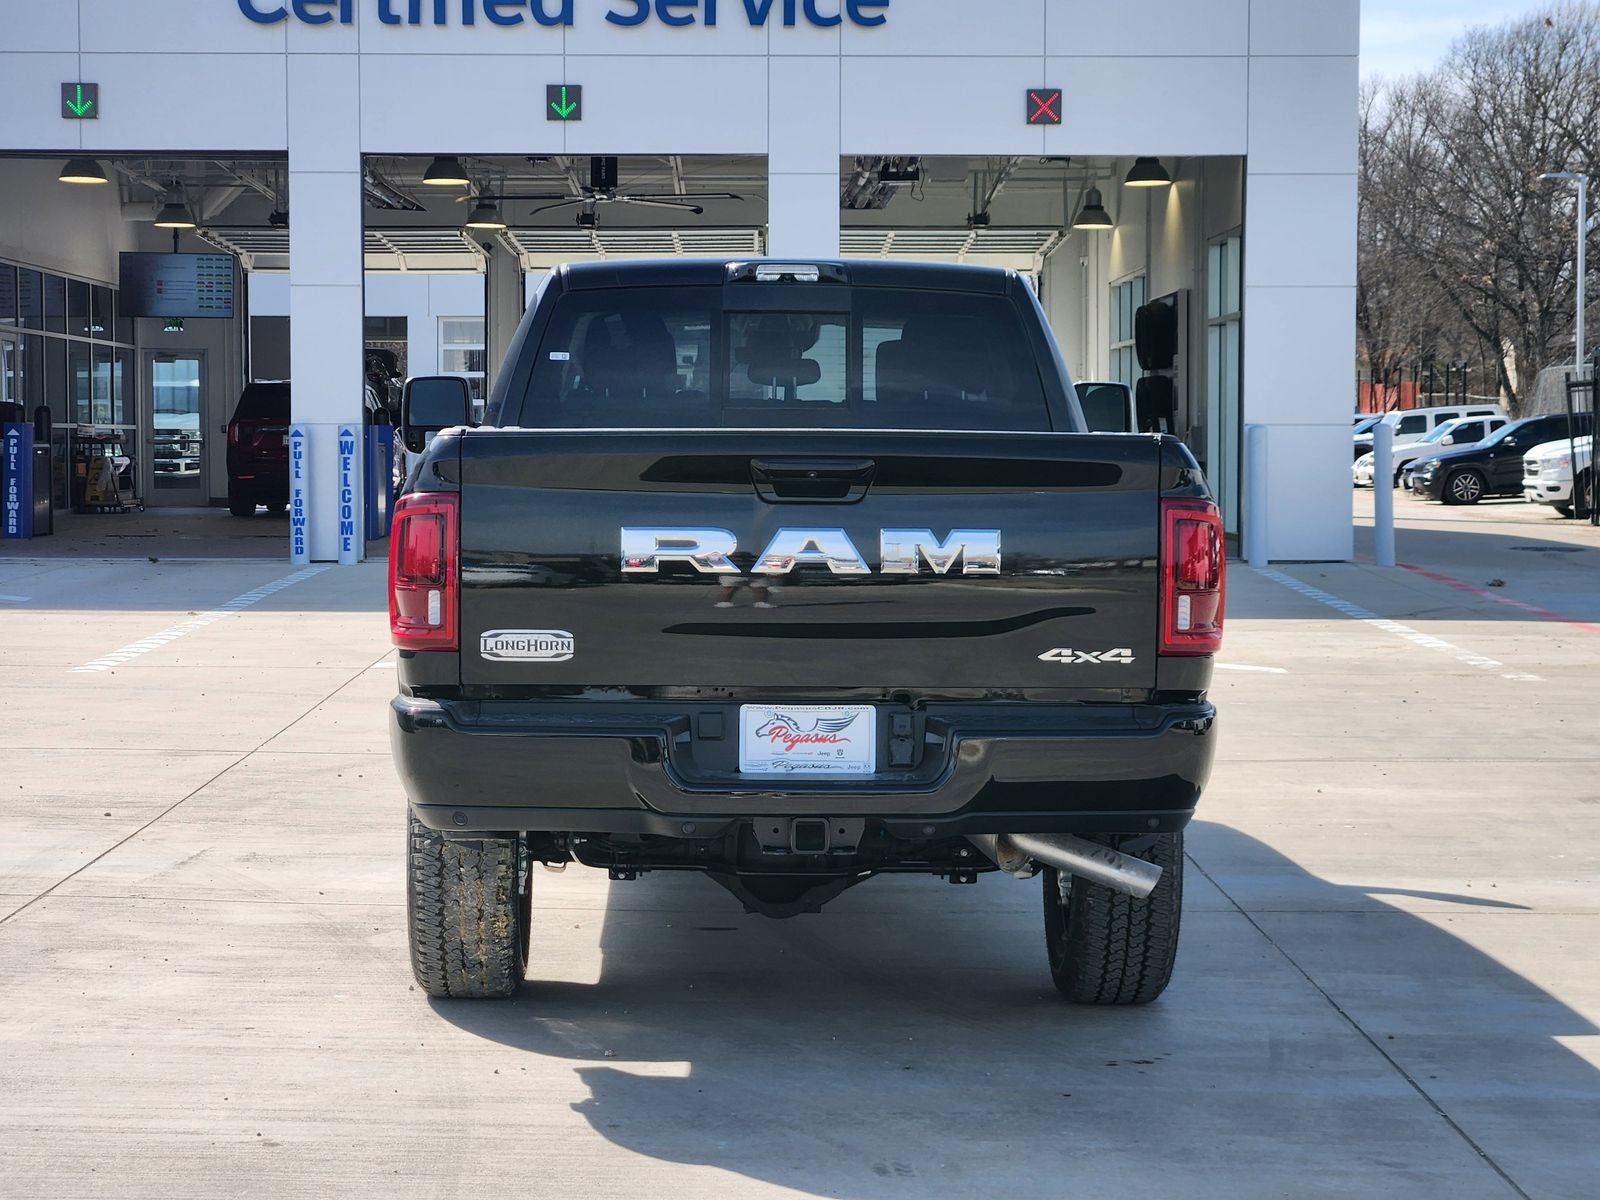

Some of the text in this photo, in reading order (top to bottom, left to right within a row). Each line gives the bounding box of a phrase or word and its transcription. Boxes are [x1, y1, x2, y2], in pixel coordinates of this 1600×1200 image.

[6, 438, 20, 534] PULL FORWARD
[292, 441, 306, 555] PULL FORWARD
[339, 440, 354, 552] WELCOME
[620, 526, 1002, 575] RAM
[768, 725, 851, 752] Pegasus
